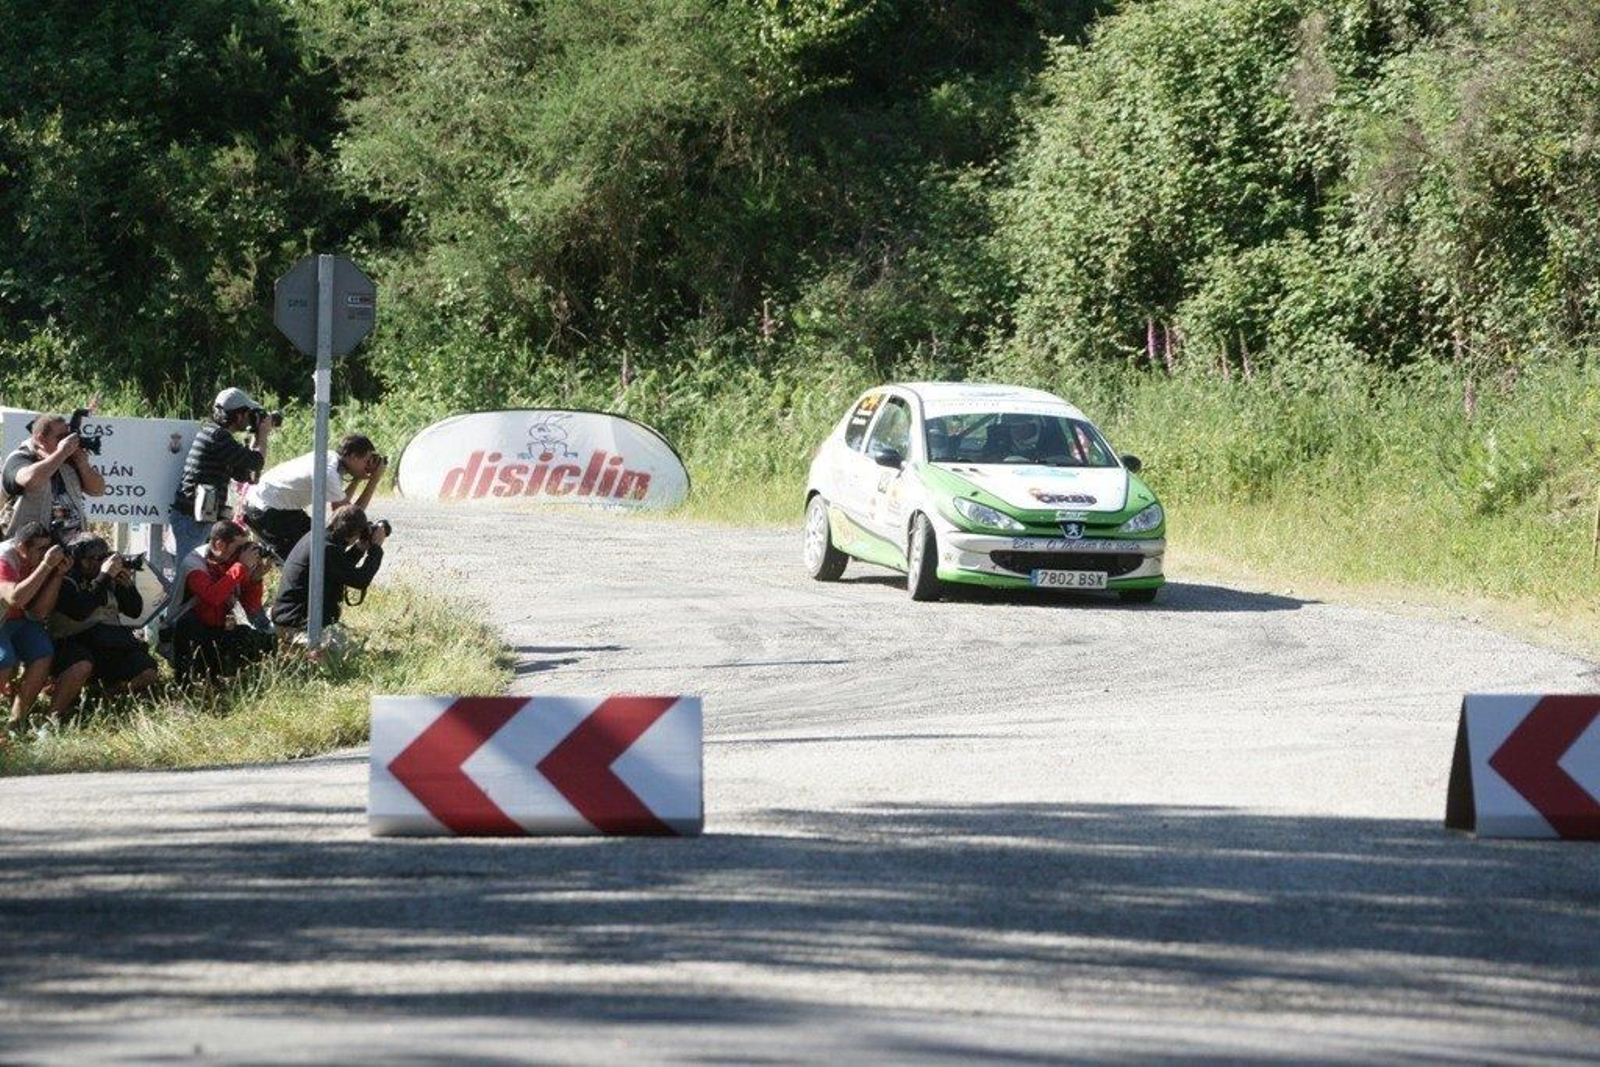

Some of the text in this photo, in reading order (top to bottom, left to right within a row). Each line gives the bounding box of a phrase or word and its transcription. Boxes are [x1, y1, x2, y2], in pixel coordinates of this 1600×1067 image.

[81, 424, 114, 437] CAS
[90, 461, 134, 477] ALÁN
[438, 449, 653, 501] disiclin
[103, 484, 146, 498] OSTO
[90, 503, 160, 517] MAGINA
[1040, 571, 1104, 587] 7802 BSX
